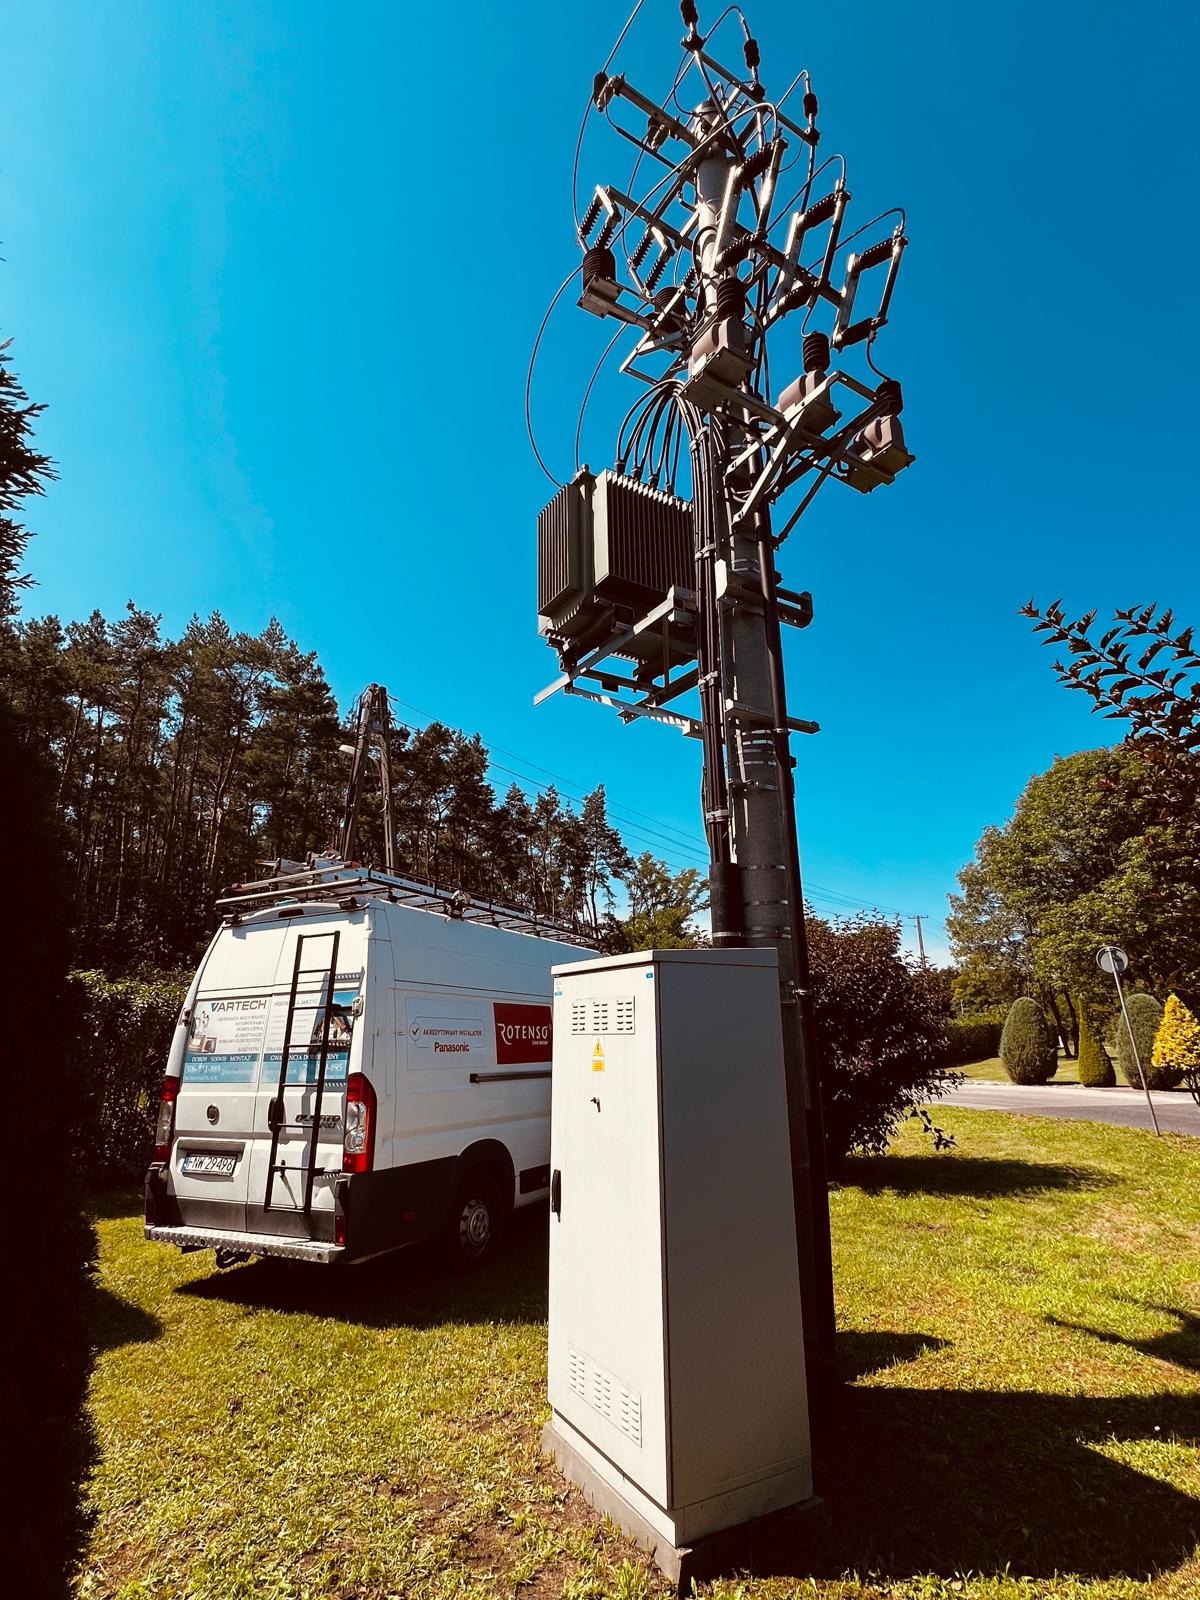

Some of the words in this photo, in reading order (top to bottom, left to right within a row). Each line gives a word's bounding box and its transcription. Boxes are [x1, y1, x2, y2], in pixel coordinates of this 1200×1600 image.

[211, 1000, 267, 1012] VARTECH
[497, 1023, 548, 1045] ROTENSO
[434, 1041, 470, 1053] Panasonic
[205, 1156, 235, 1172] 29496
